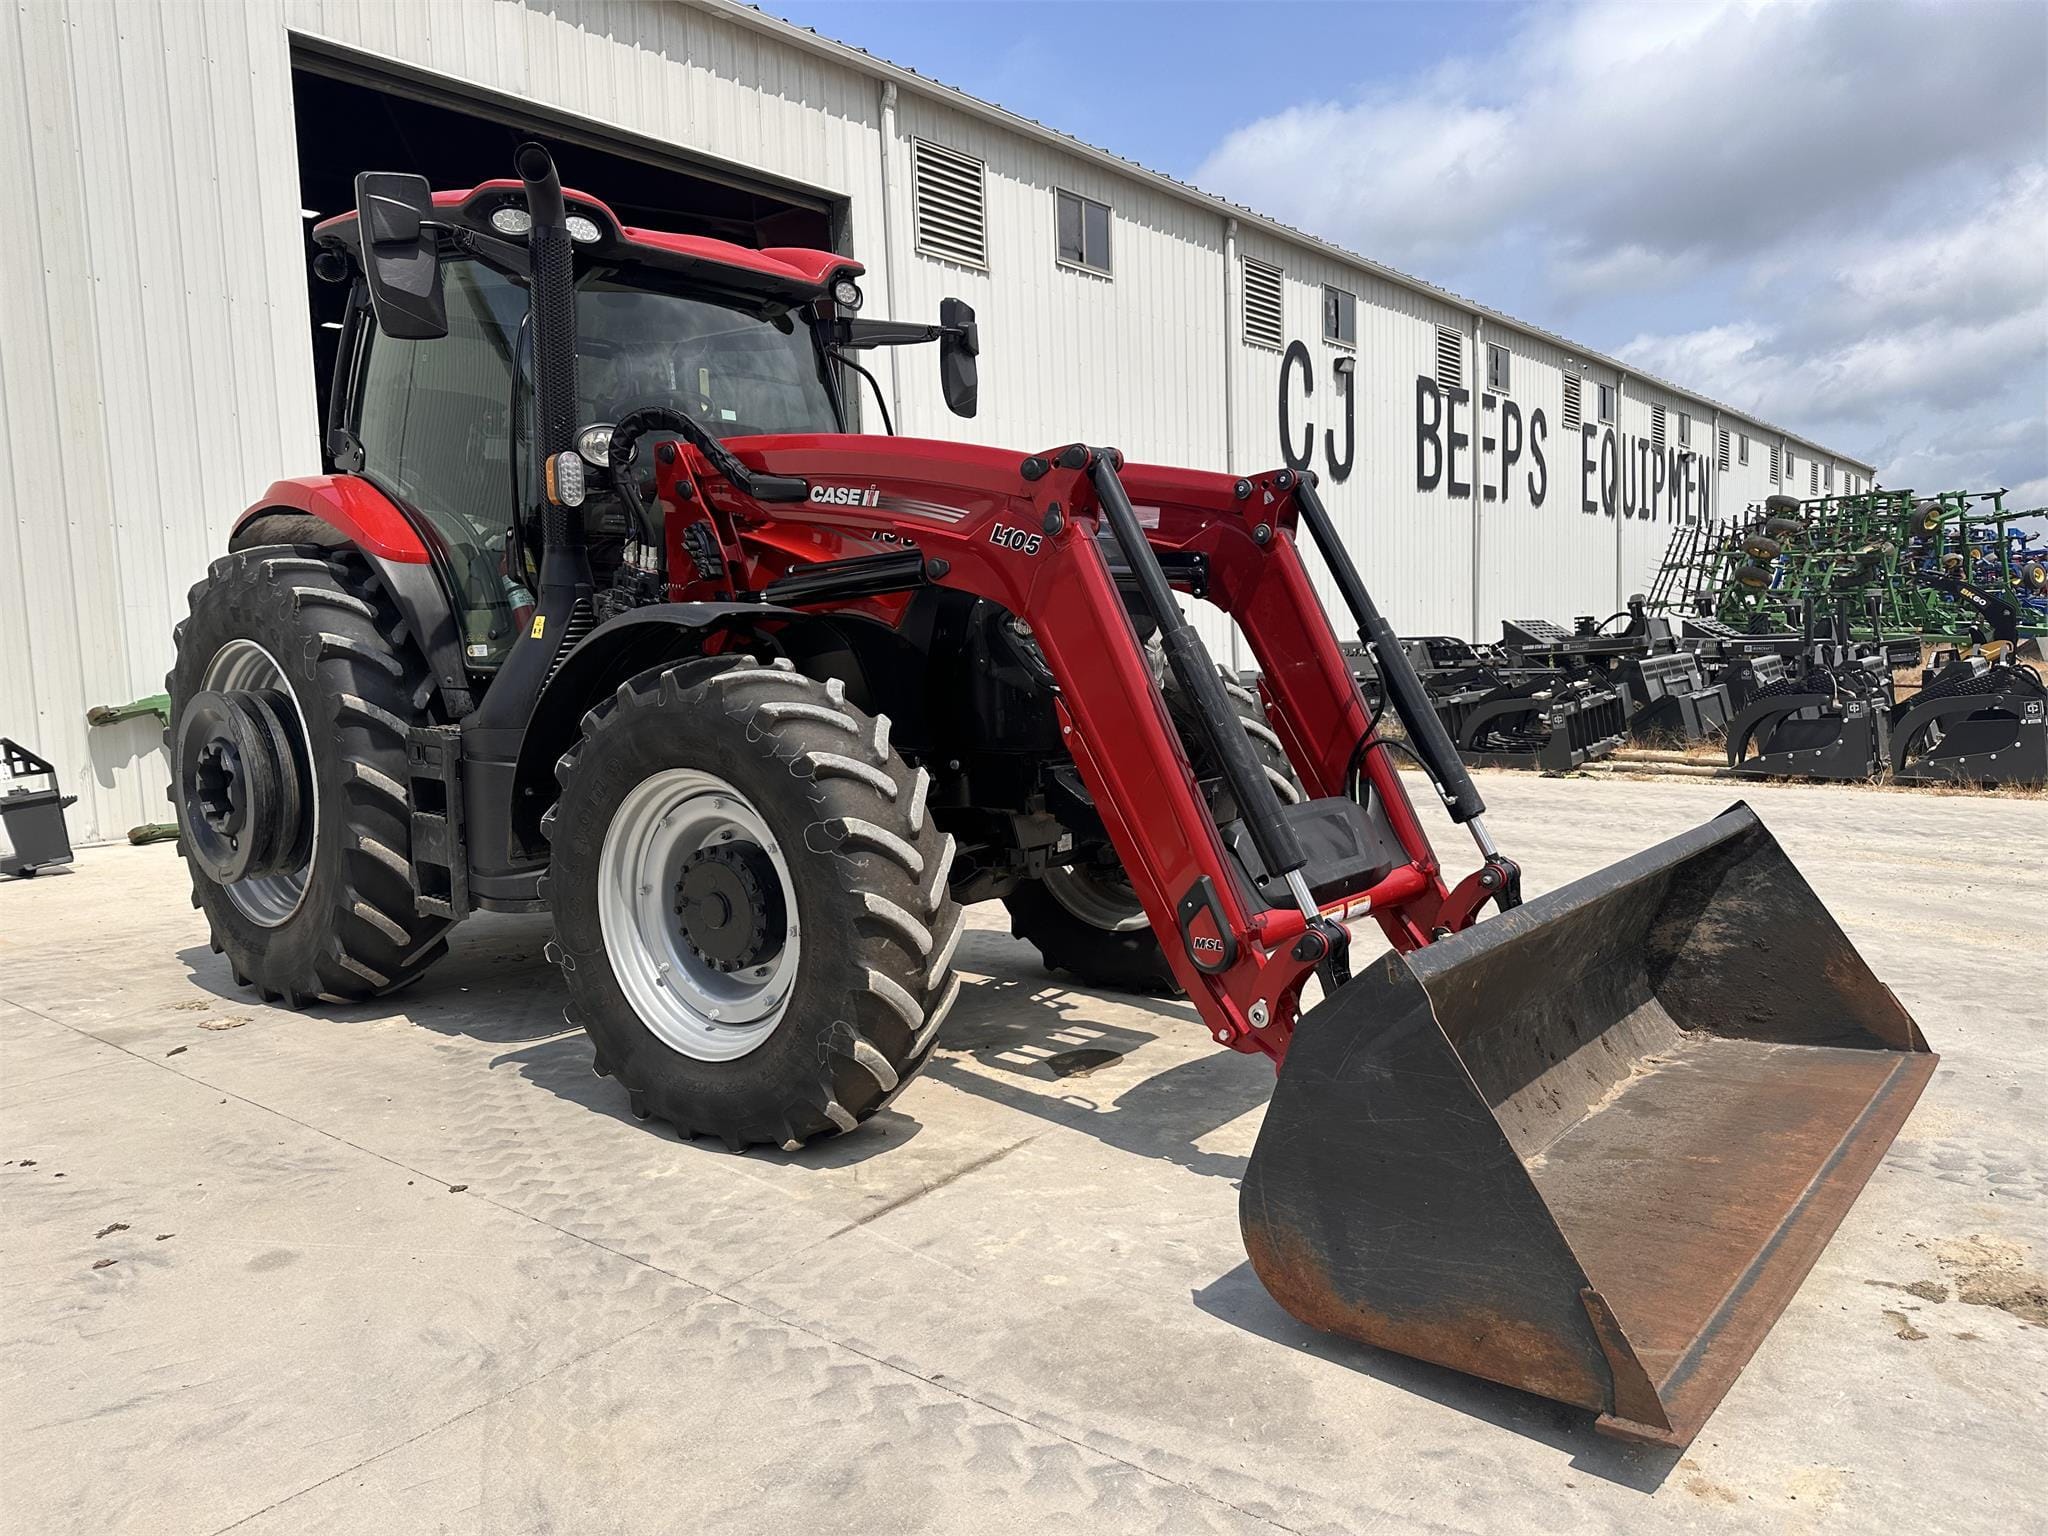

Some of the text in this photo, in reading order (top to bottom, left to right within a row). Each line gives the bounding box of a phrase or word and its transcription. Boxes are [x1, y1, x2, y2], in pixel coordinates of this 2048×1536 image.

[1279, 340, 1722, 527] CJ BEEPS EQUIPMEN
[810, 485, 861, 505] CASE
[989, 522, 1043, 556] L105
[1193, 936, 1225, 952] MSL
